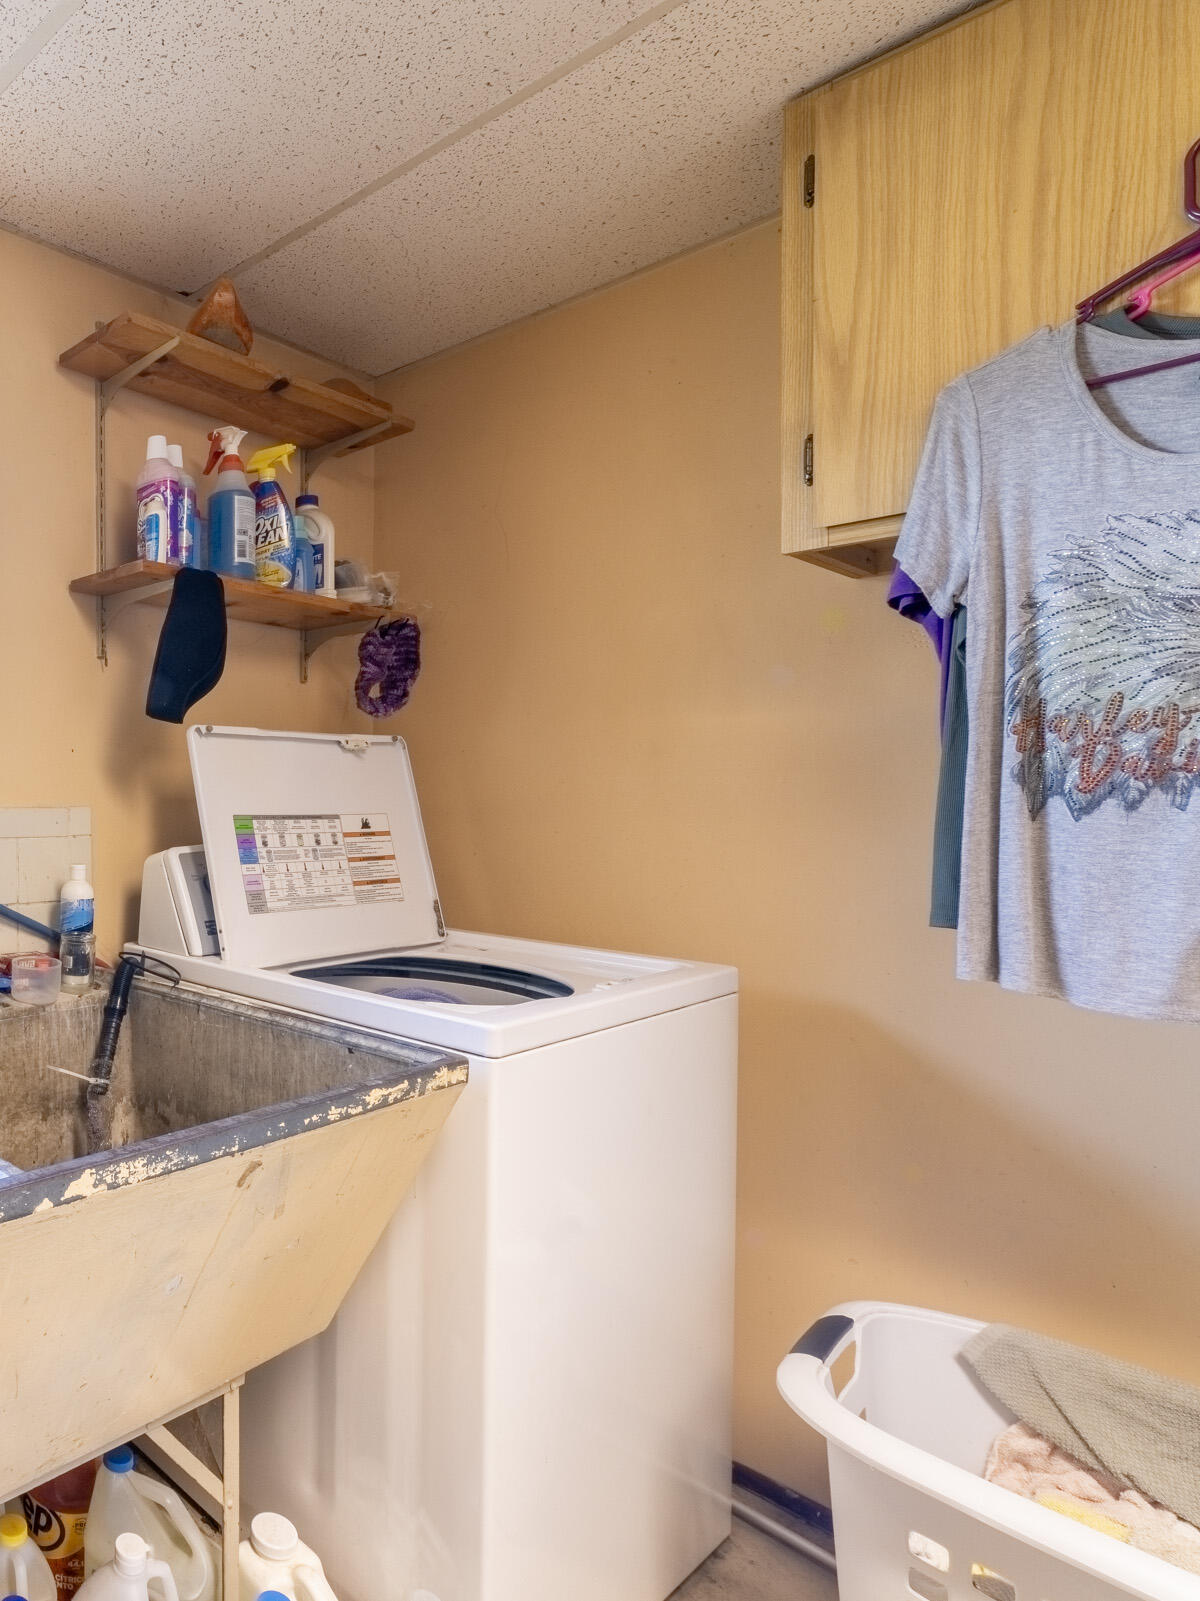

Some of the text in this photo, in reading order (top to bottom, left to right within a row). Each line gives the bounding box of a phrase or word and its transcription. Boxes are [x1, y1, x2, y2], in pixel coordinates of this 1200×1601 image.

[256, 515, 278, 536] OXI
[1070, 738, 1200, 794] Davi
[23, 1495, 53, 1536] ep
[55, 1574, 82, 1584] CÍTRIC
